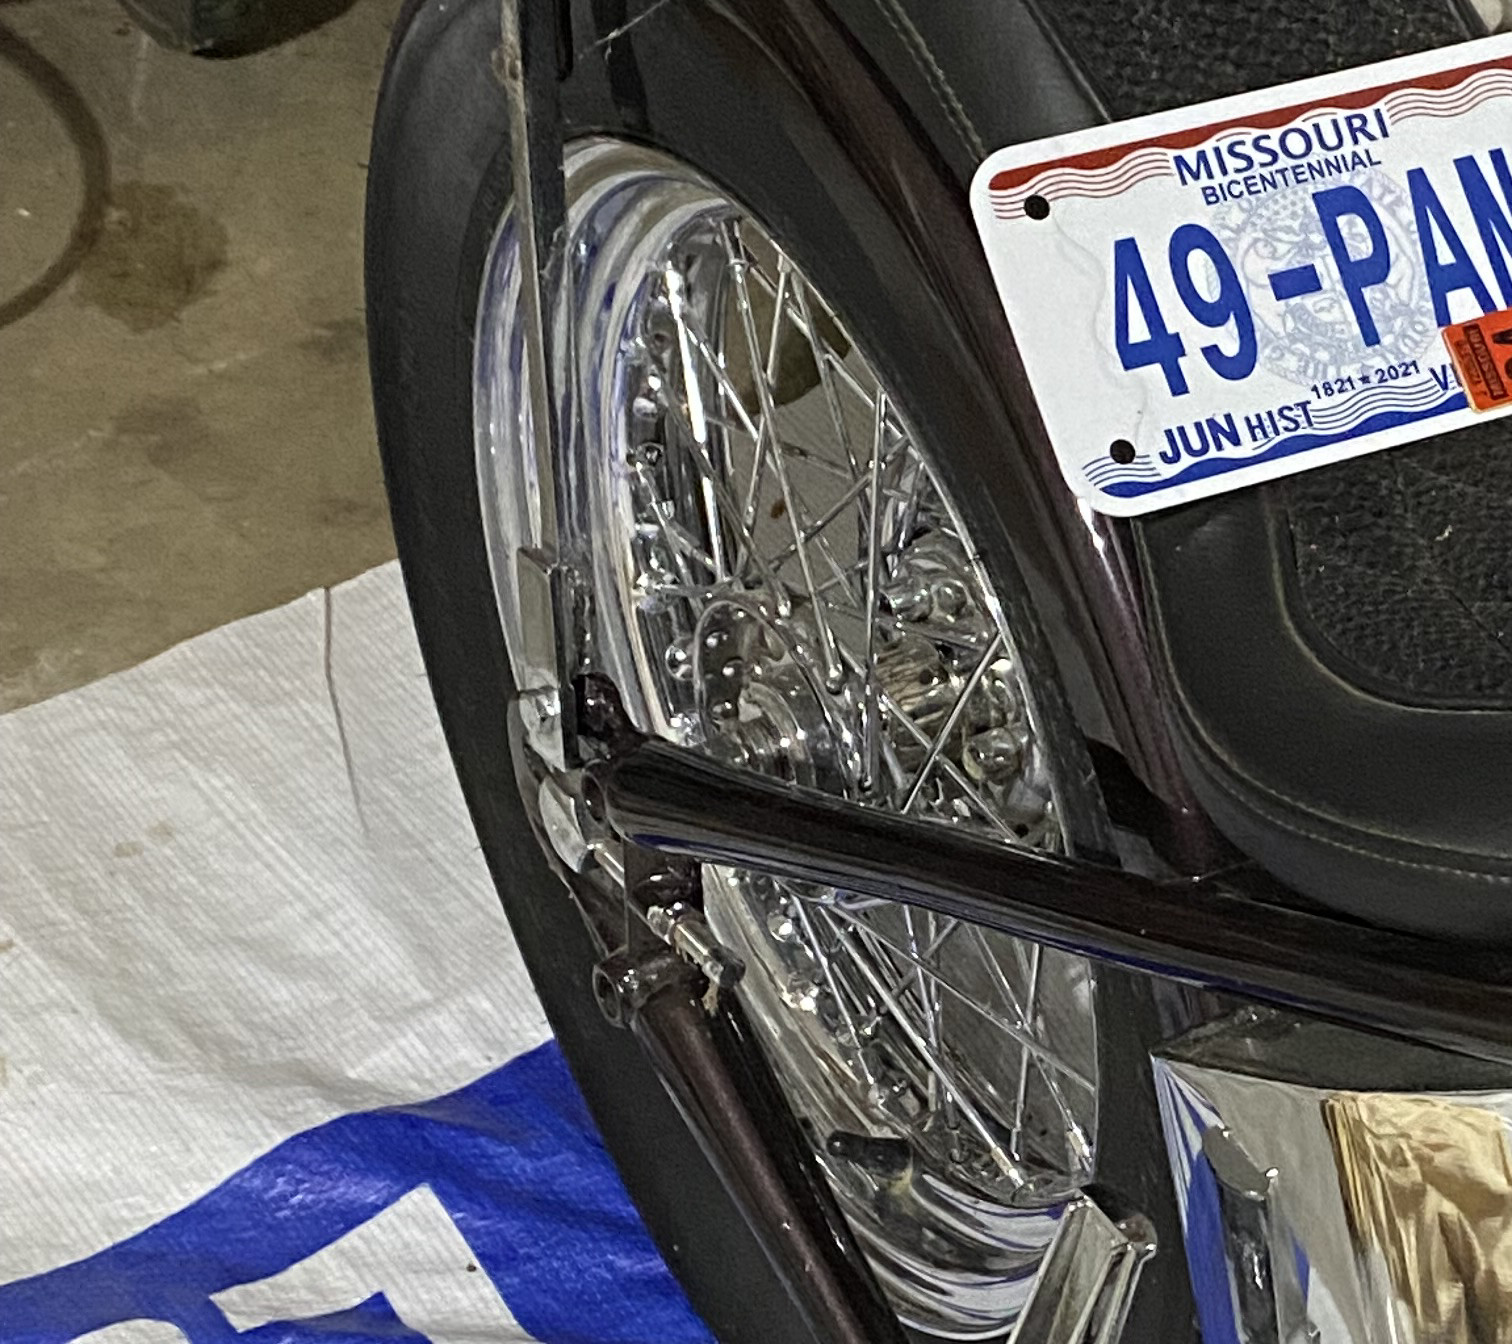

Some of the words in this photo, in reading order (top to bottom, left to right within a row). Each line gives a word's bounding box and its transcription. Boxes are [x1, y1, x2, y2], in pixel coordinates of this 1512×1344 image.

[1173, 108, 1390, 186] MISSOURI
[1200, 149, 1382, 206] BICENTENNIAL
[1310, 373, 1356, 400] 1821
[1374, 359, 1420, 385] 2021
[1159, 412, 1242, 464] JUN
[1243, 399, 1315, 443] HIST
